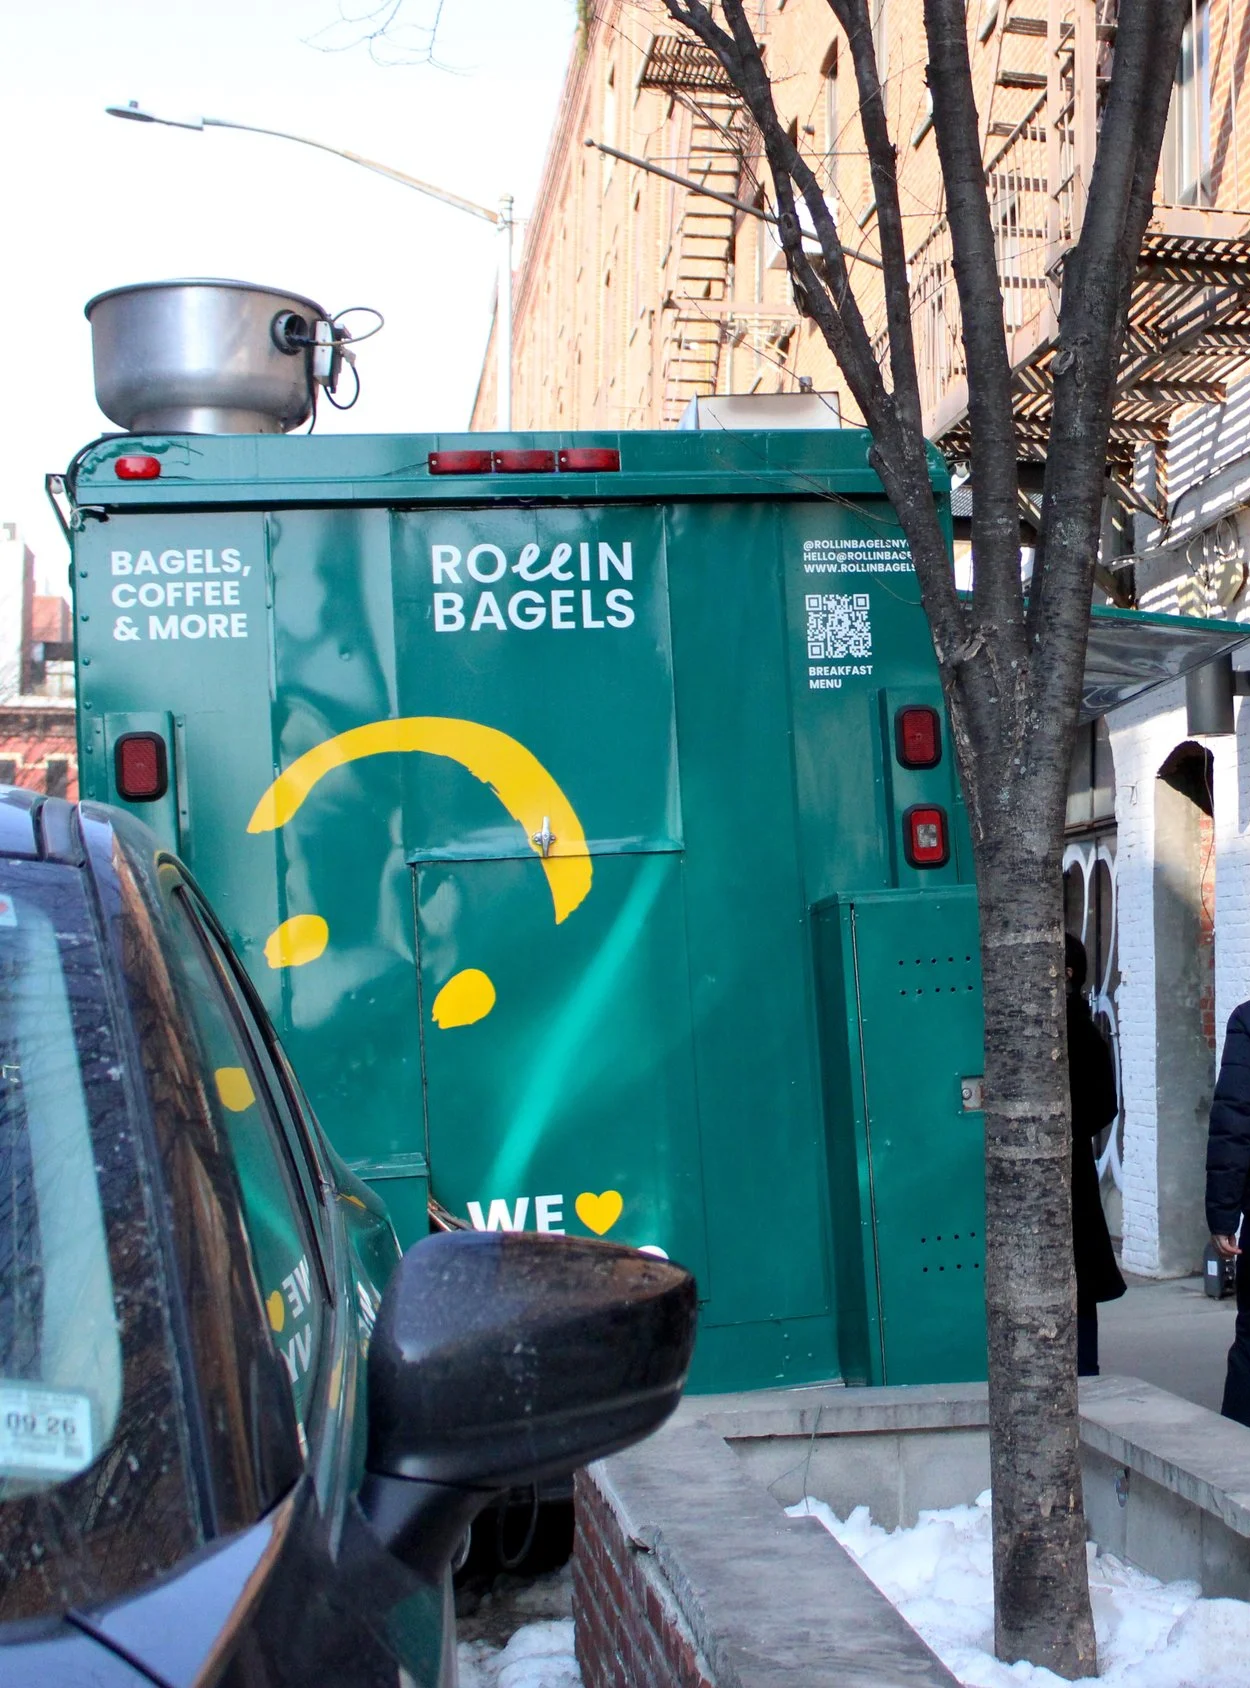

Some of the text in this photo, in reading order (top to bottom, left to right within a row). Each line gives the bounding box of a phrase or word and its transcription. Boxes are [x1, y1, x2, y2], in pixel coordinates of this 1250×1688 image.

[803, 539, 909, 551] @ROLLINBAGELSNY
[110, 548, 251, 576] BAGELS,
[110, 580, 240, 609] COFFEE
[433, 588, 635, 632] BAGELS
[112, 613, 249, 641] & MORE
[808, 665, 873, 676] BREAKFAST
[809, 679, 842, 689] MENU
[466, 1194, 566, 1236] WE
